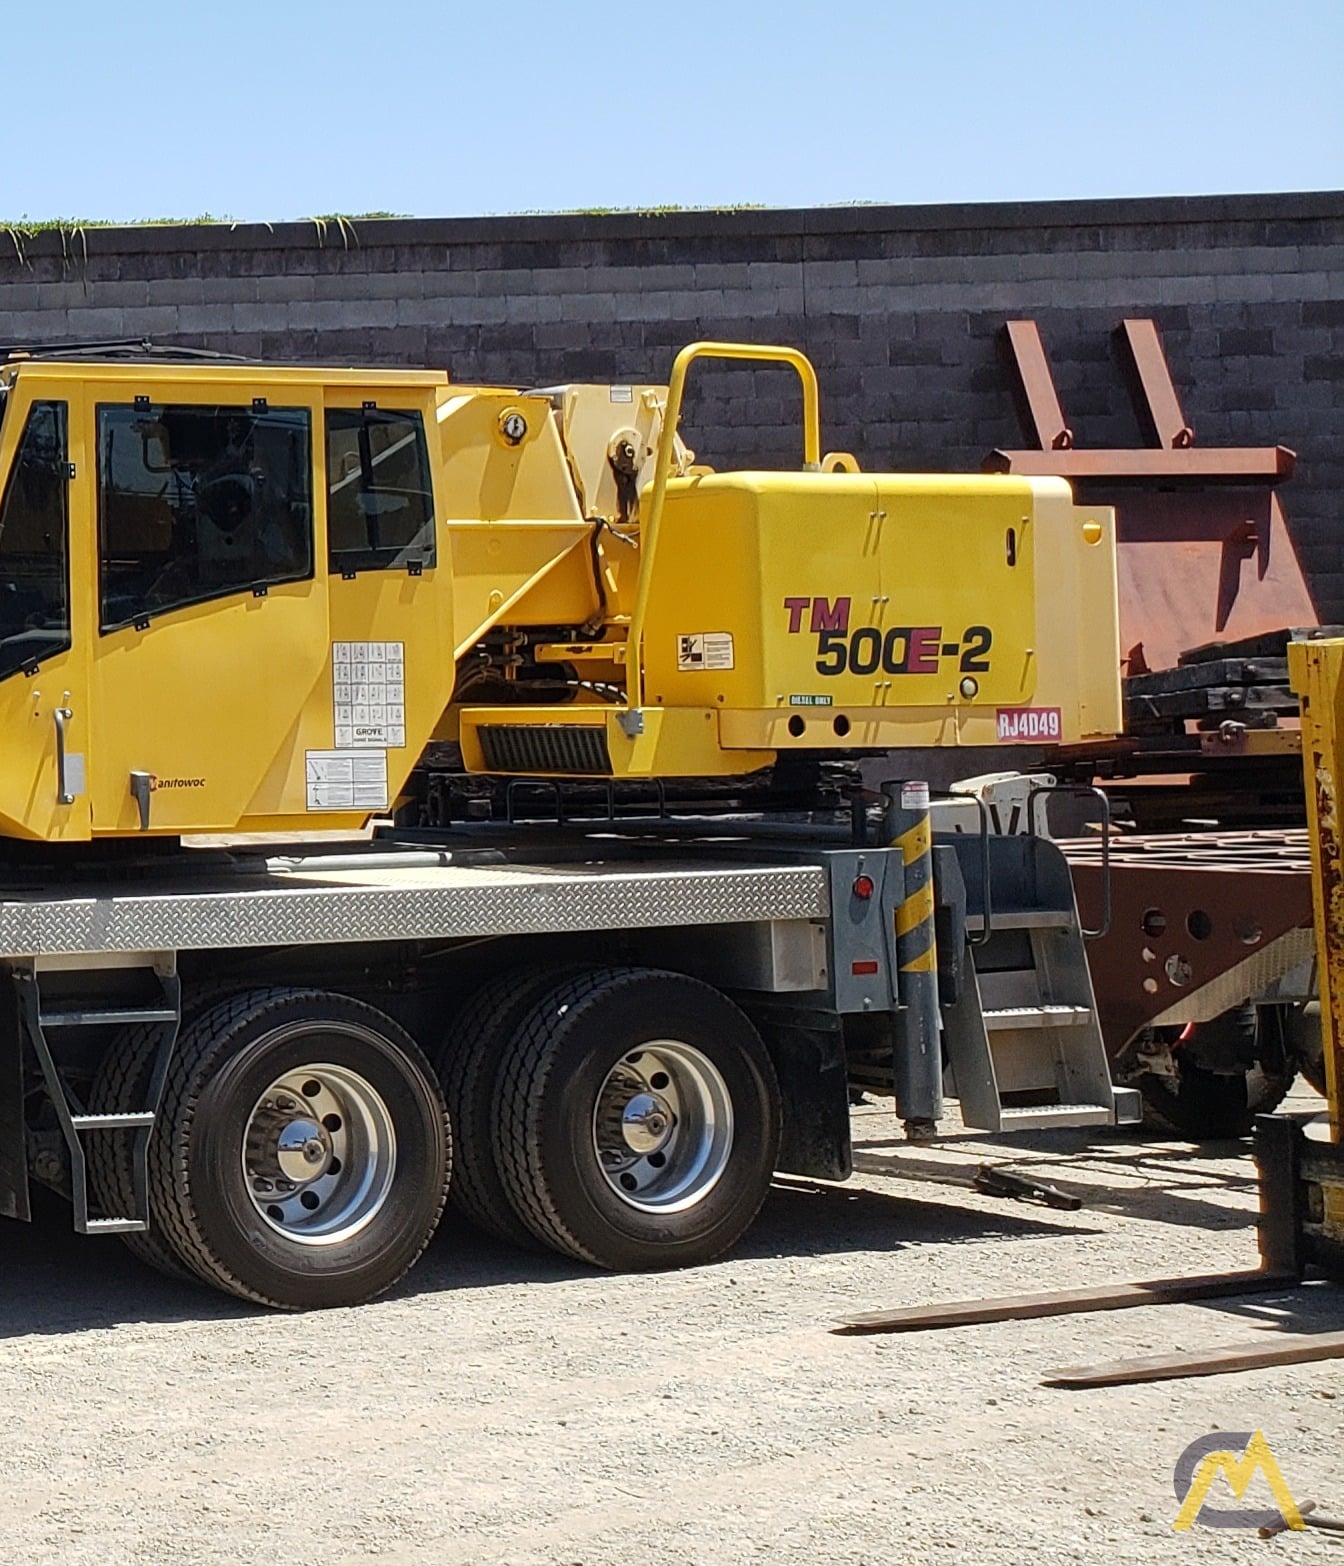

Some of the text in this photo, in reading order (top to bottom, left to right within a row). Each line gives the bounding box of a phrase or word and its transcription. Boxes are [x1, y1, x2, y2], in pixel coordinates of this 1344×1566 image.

[784, 597, 851, 633] TM
[355, 728, 383, 736] GROVE
[999, 712, 1059, 737] RJ4D49
